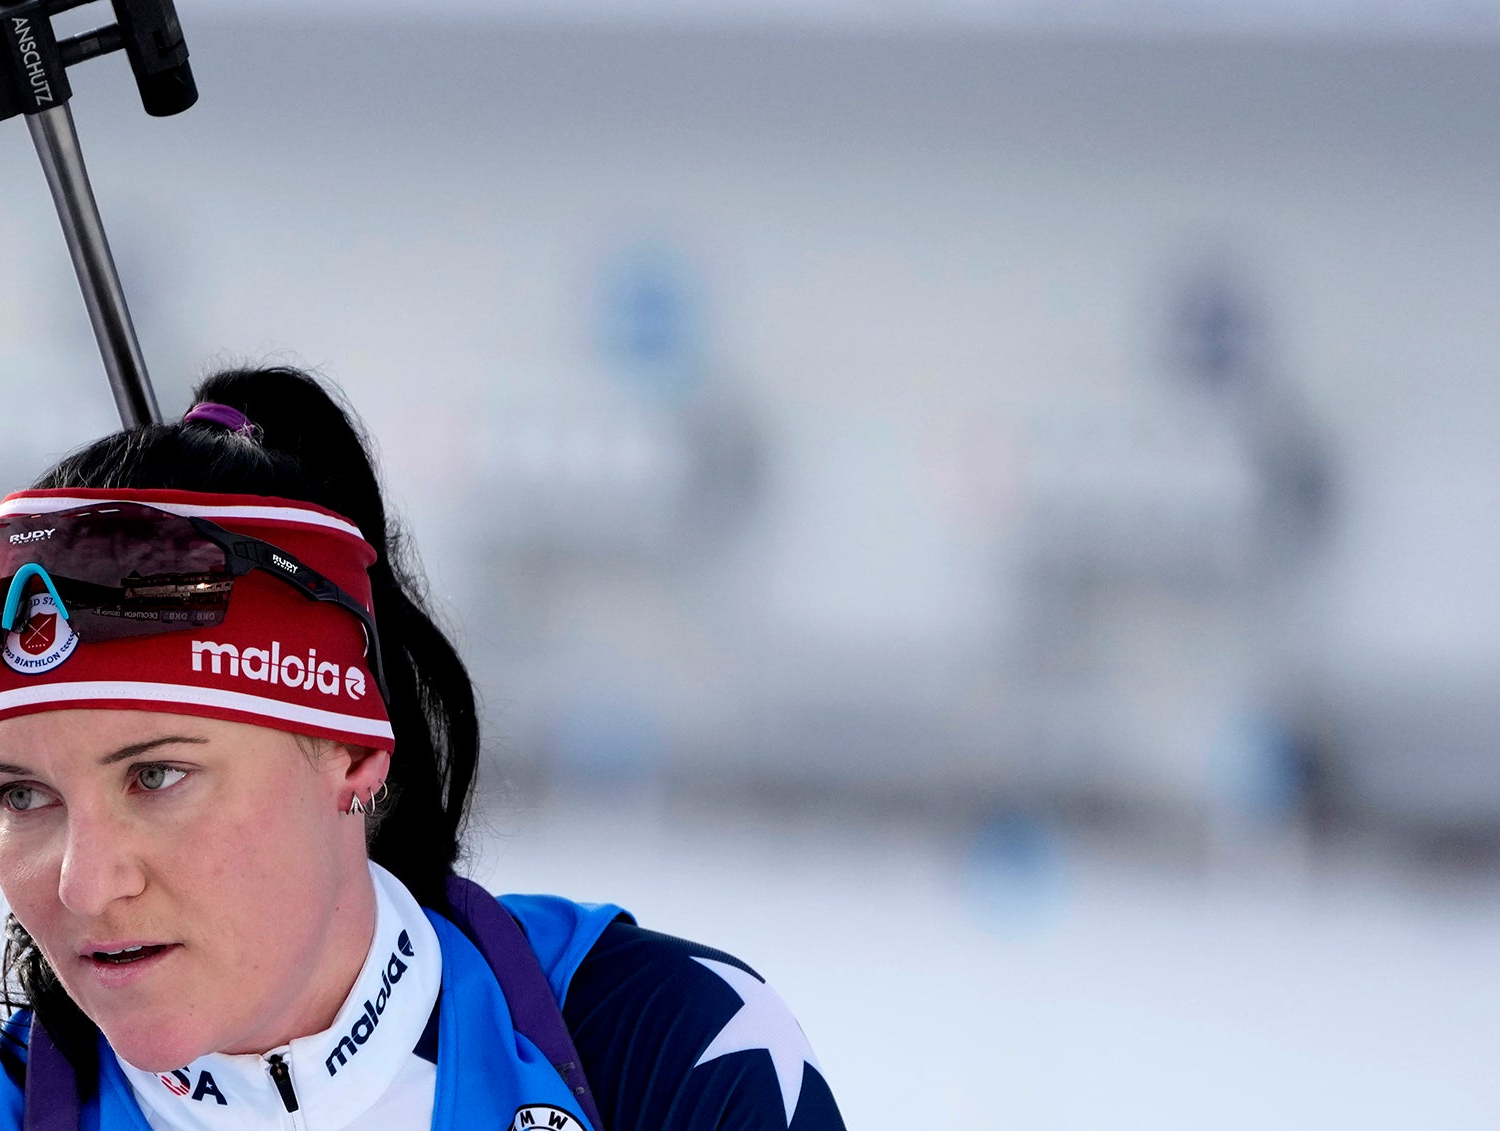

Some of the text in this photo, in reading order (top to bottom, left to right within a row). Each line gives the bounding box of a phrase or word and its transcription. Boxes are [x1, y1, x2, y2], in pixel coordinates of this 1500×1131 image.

[11, 16, 53, 106] ANSCHÜTZ
[9, 528, 56, 543] RUDY
[272, 553, 299, 574] RUDY
[14, 652, 61, 668] BIATHLON
[191, 640, 341, 696] maloja
[325, 952, 409, 1077] maloja
